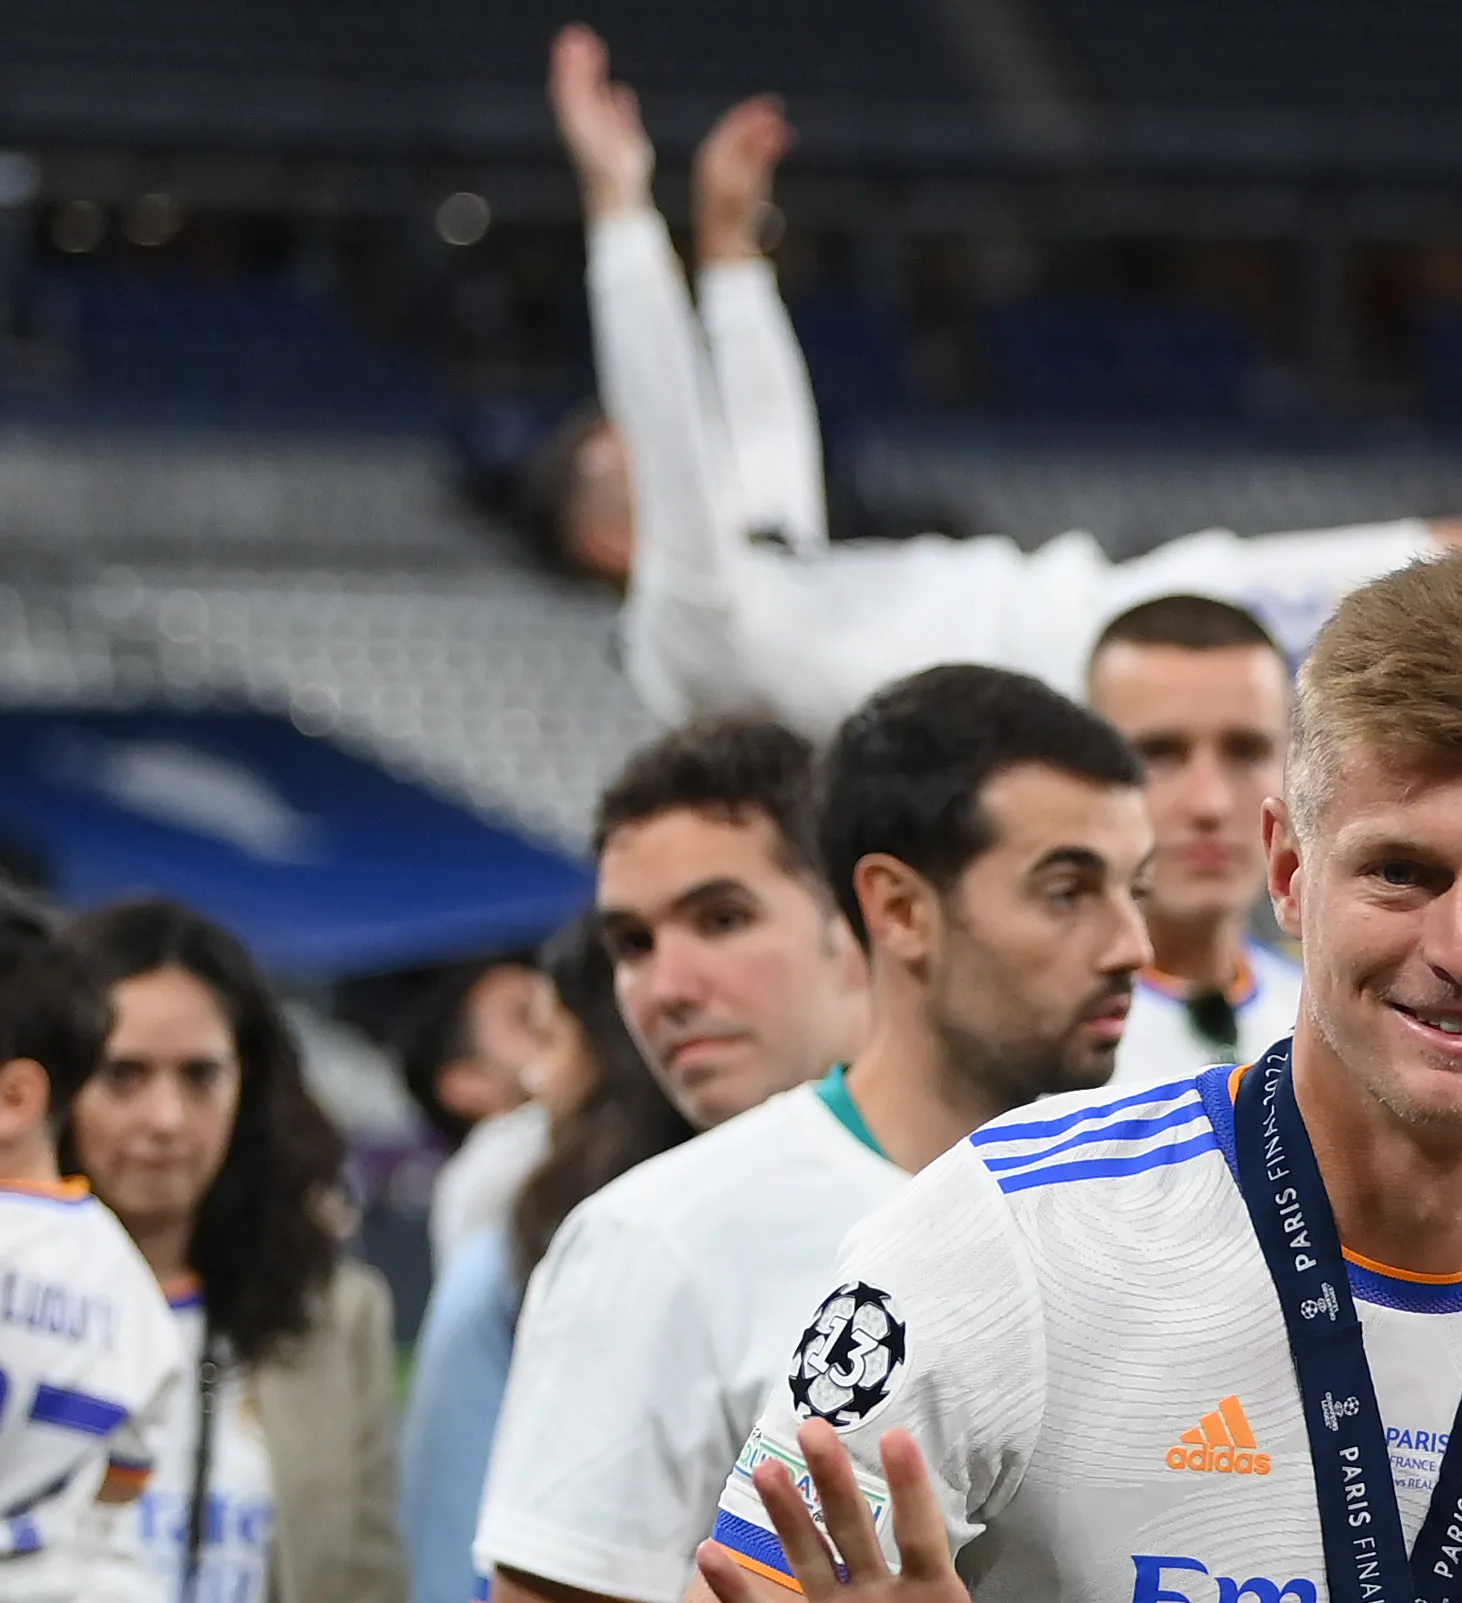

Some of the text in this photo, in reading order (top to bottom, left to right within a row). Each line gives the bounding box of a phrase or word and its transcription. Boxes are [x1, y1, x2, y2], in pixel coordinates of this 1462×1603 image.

[1275, 1187, 1318, 1272] PARIS
[807, 1315, 880, 1389] 13
[1166, 1442, 1271, 1475] adidas
[1386, 1427, 1450, 1455] PARIS
[1390, 1456, 1437, 1472] FRANCE
[1339, 1446, 1371, 1527] PARIS
